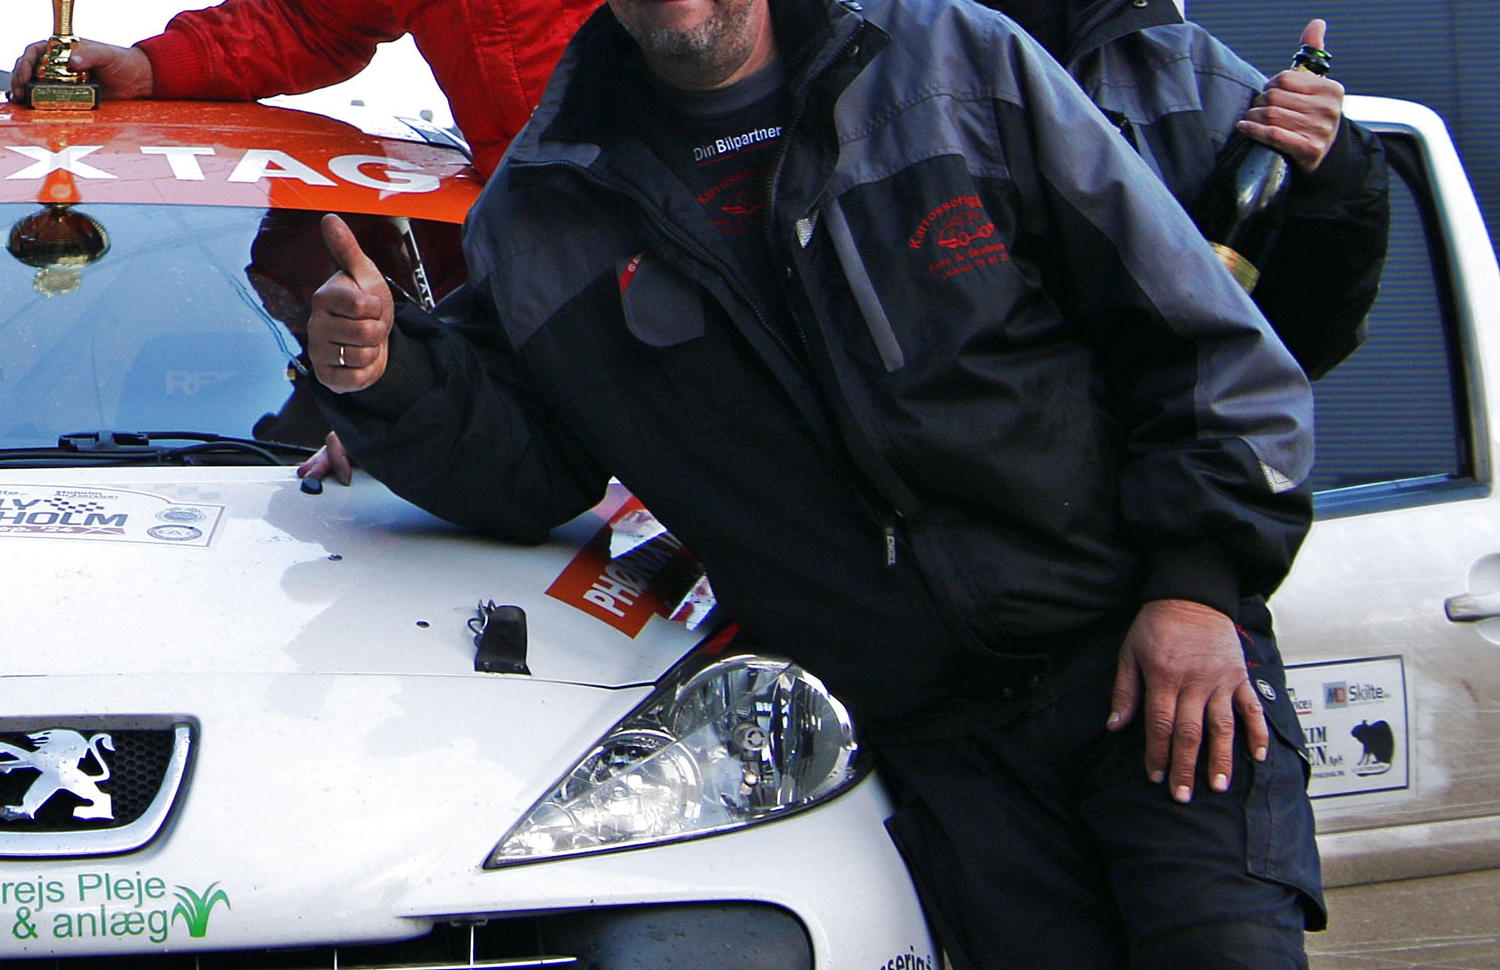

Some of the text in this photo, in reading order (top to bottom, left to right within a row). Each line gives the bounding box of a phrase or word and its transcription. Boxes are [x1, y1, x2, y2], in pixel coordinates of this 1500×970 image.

[693, 126, 782, 161] Din Bilpartner
[140, 145, 441, 194] TAG
[1348, 683, 1384, 702] Skilte
[77, 871, 166, 907] Pleje
[12, 904, 168, 943] & anlæg
